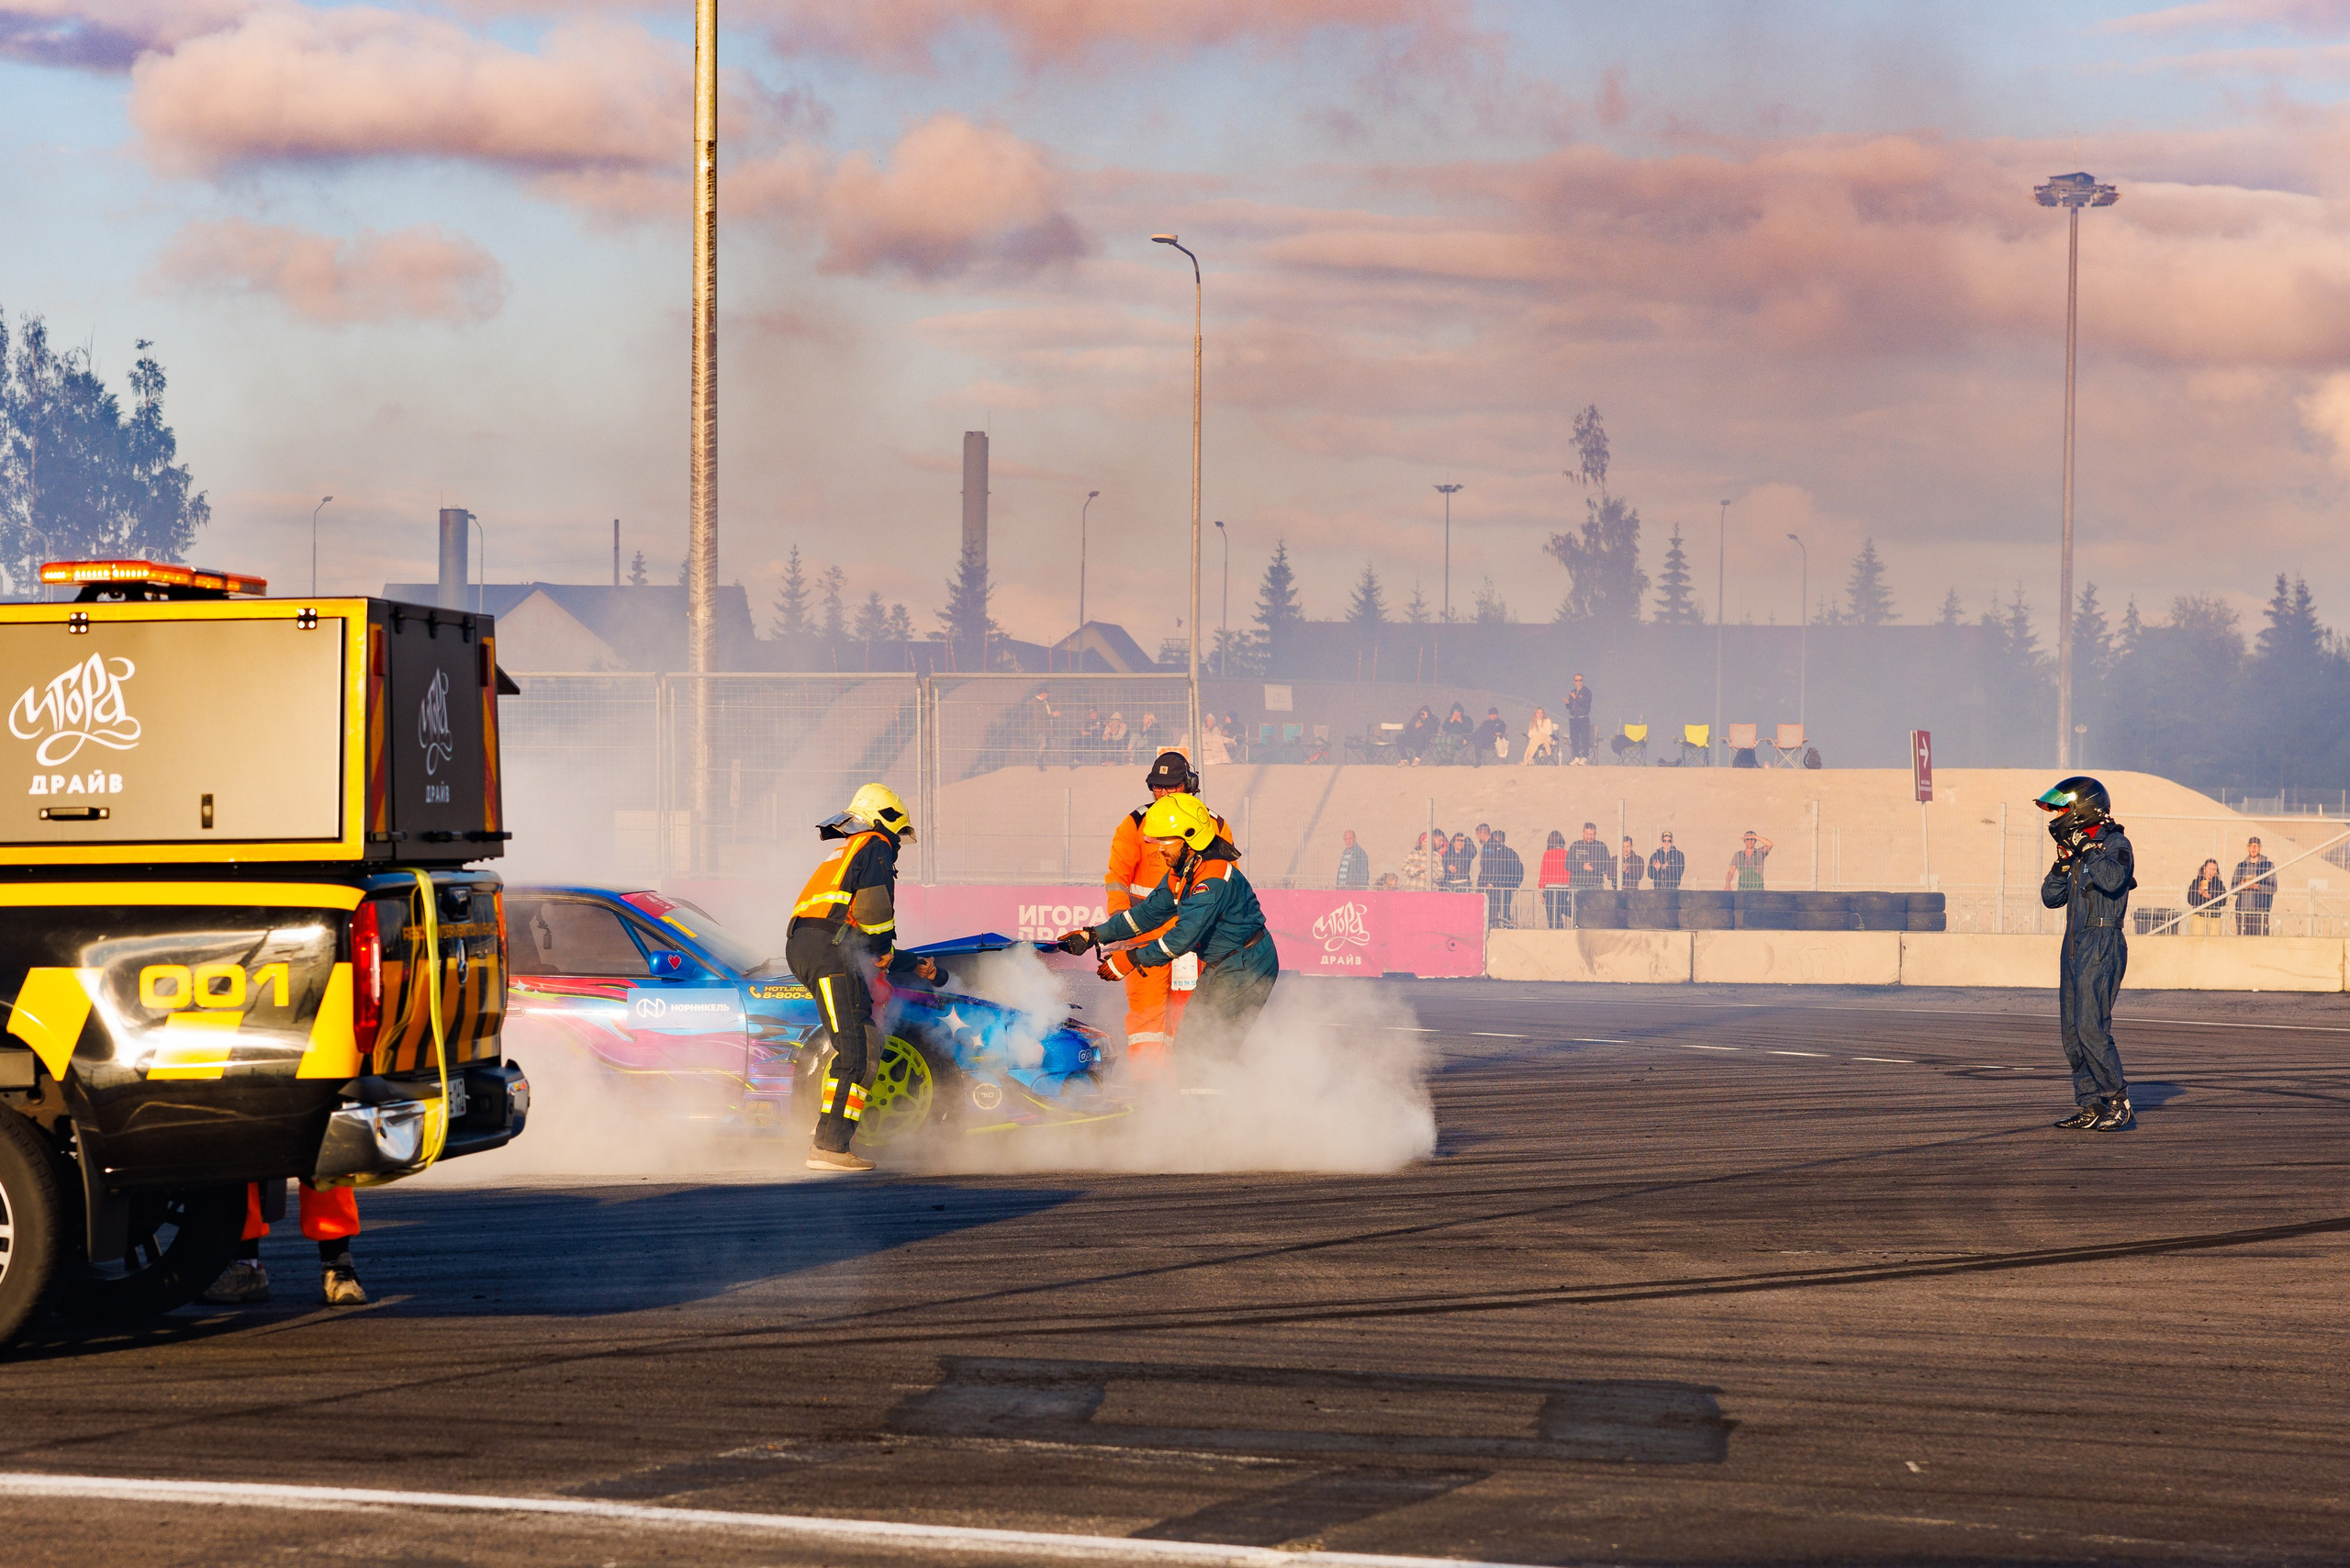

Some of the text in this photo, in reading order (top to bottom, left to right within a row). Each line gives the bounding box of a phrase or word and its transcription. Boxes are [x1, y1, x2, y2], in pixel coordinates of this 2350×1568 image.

[28, 768, 124, 795] ДРАЙВ
[425, 780, 450, 803] ДРАЙВ
[1018, 905, 1108, 925] ИГОРА
[1320, 955, 1361, 965] ДРАЙВ
[139, 963, 290, 1008] 001
[670, 1003, 730, 1012] НОРНИКЕЛЬ
